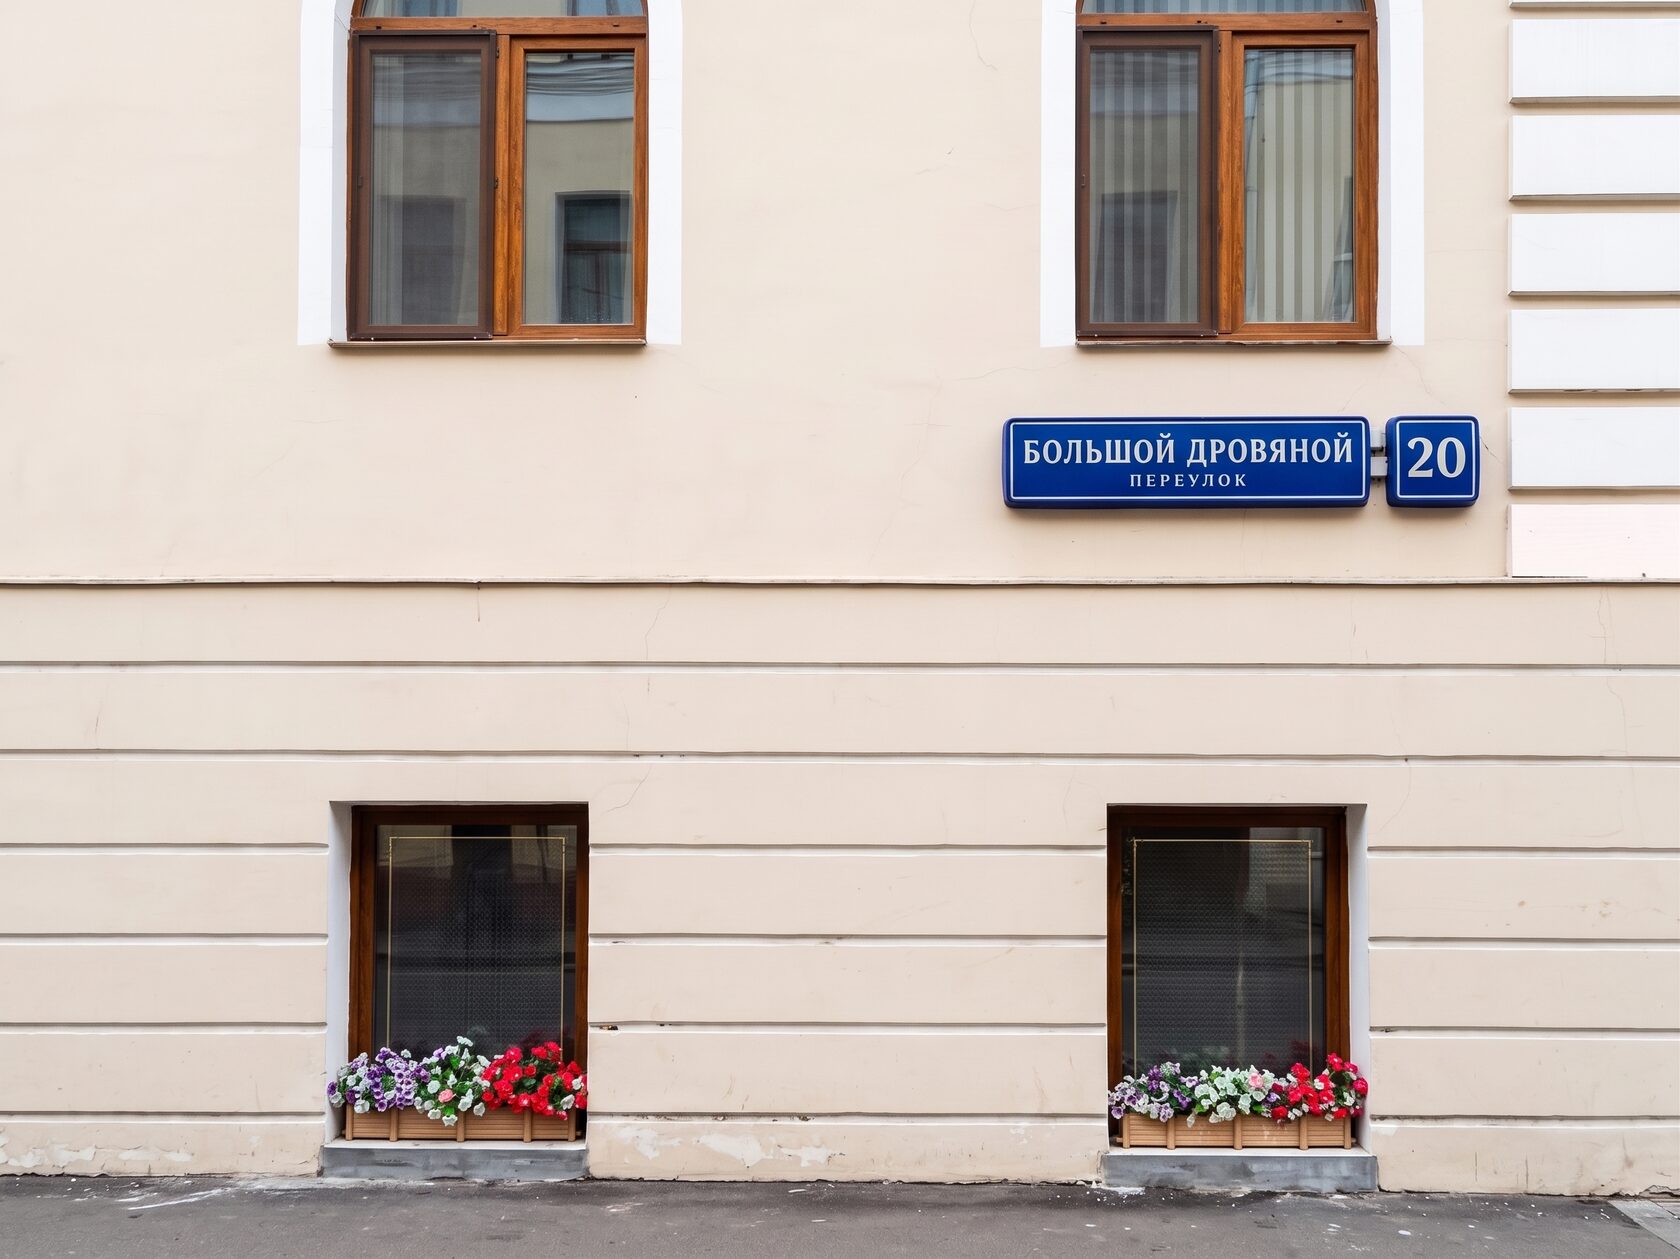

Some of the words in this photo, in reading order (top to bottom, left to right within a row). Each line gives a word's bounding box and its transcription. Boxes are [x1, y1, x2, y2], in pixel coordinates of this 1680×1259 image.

[1023, 432, 1176, 465] БОЛЬШОЙ
[1186, 431, 1353, 467] ДРОВЯНОЙ
[1407, 436, 1467, 478] 20
[1129, 473, 1247, 487] ПЕРЕУЛОК
